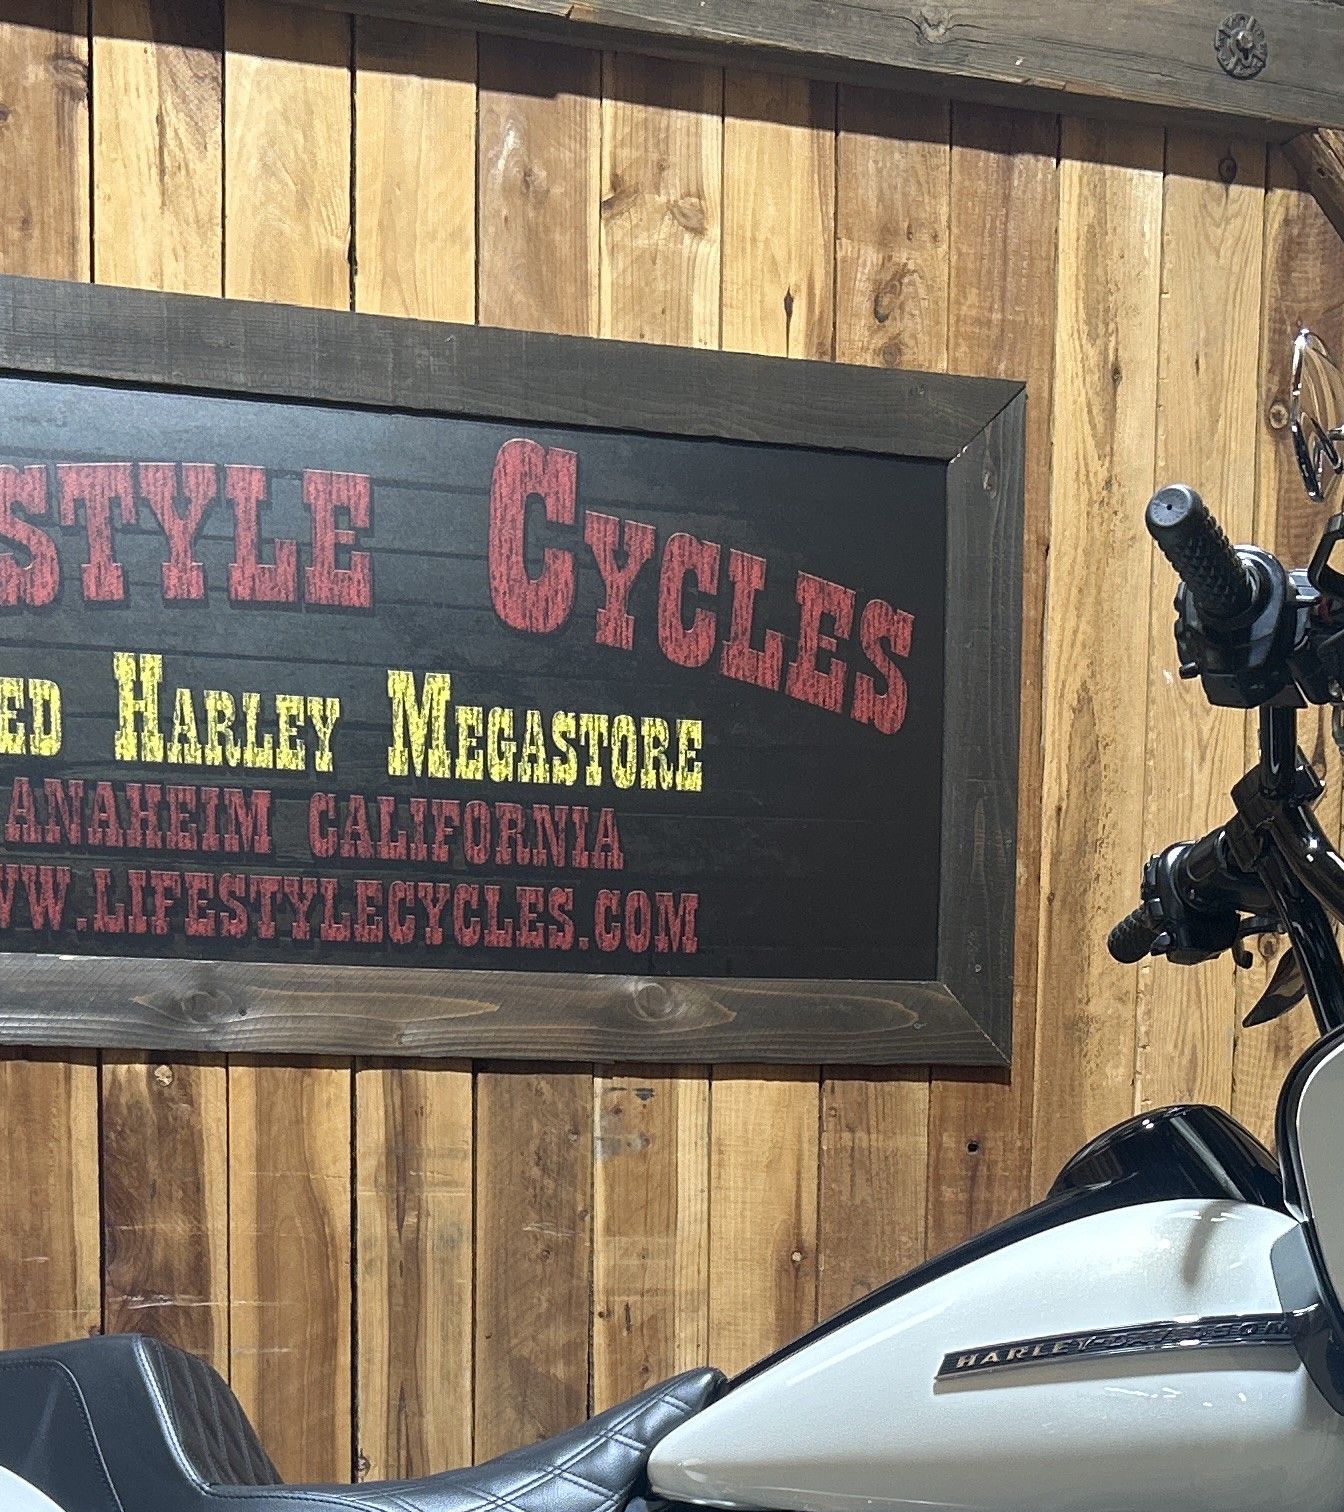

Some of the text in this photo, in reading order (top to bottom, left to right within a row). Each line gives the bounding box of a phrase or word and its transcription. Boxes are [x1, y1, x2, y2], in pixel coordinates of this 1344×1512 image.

[488, 437, 916, 736] CYCLES
[113, 651, 341, 773] HARLEY
[387, 669, 704, 793] MEGASTORE
[4, 776, 625, 870] ANAHEIM CALIFORNIA
